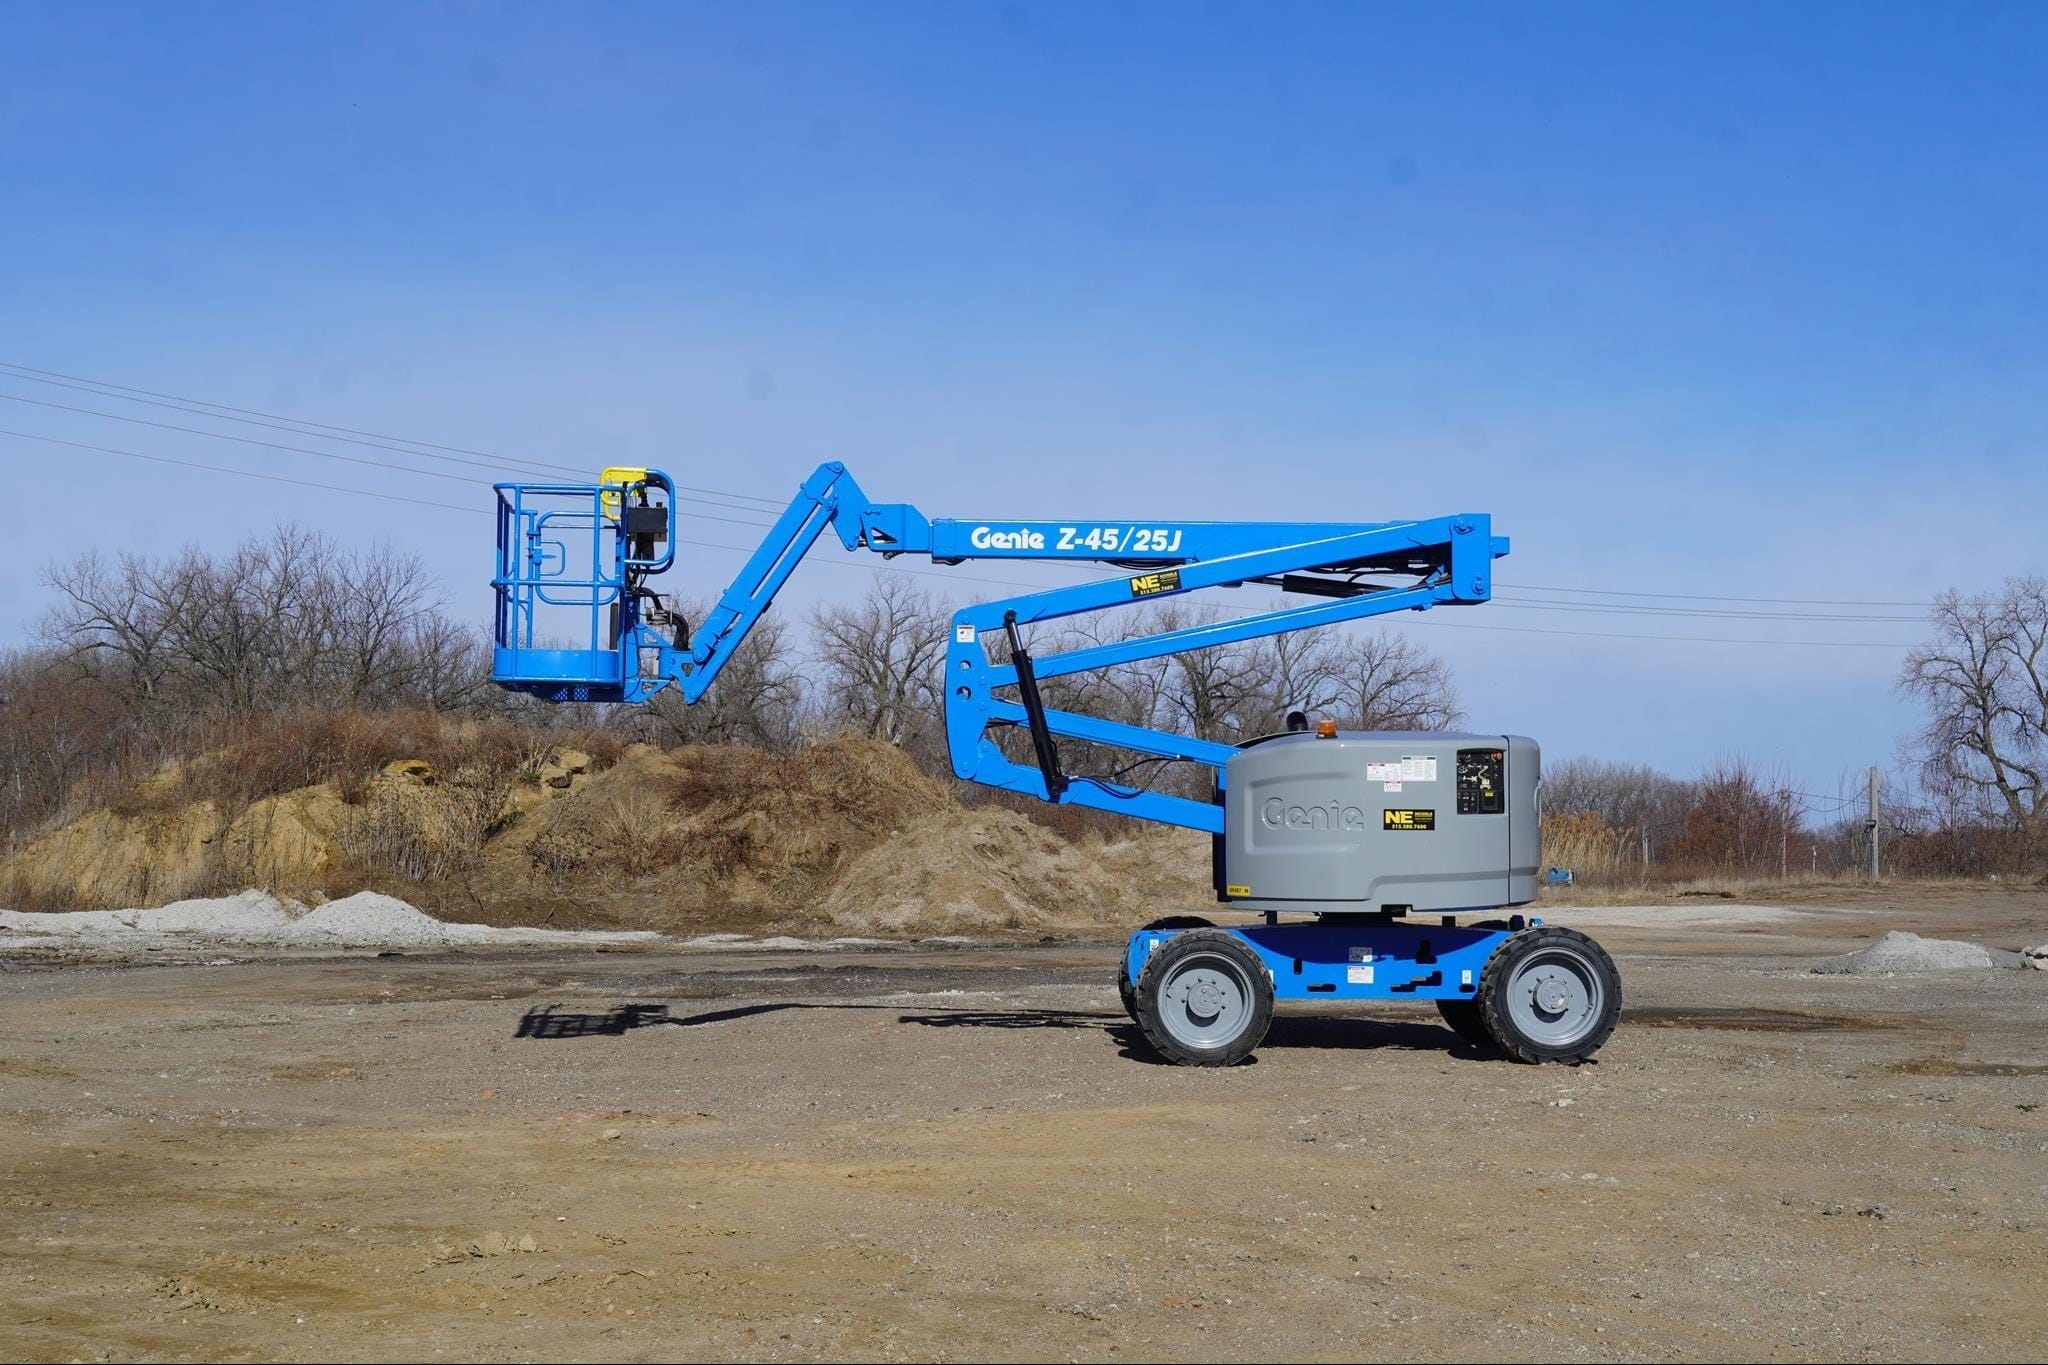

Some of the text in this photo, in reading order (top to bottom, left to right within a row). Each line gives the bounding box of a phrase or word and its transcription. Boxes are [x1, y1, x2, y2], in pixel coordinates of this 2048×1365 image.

[971, 526, 1183, 553] Genie Z-45/25J
[1131, 574, 1160, 592] NE
[1261, 796, 1364, 831] Genie
[1385, 811, 1413, 824] NE
